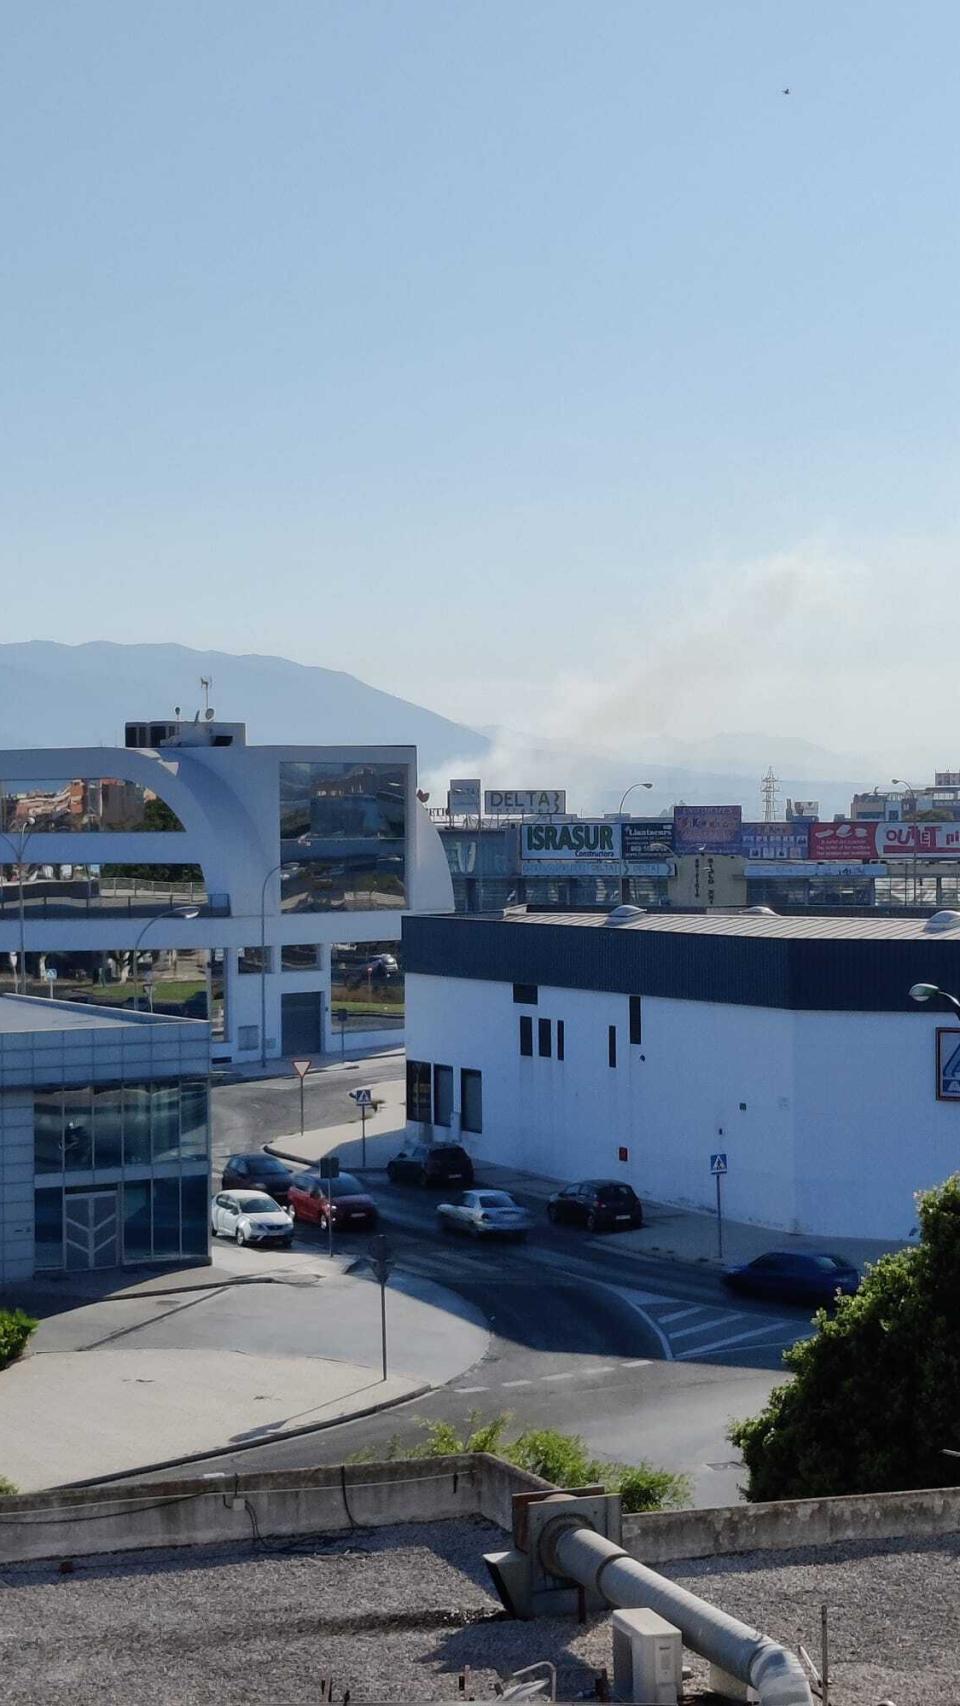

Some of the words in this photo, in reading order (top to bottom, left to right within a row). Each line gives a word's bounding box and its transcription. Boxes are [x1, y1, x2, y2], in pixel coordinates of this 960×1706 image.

[490, 792, 550, 807] DELTA
[527, 825, 614, 851] ISRASUR
[886, 825, 942, 848] OUTLET
[574, 850, 615, 858] Constructora
